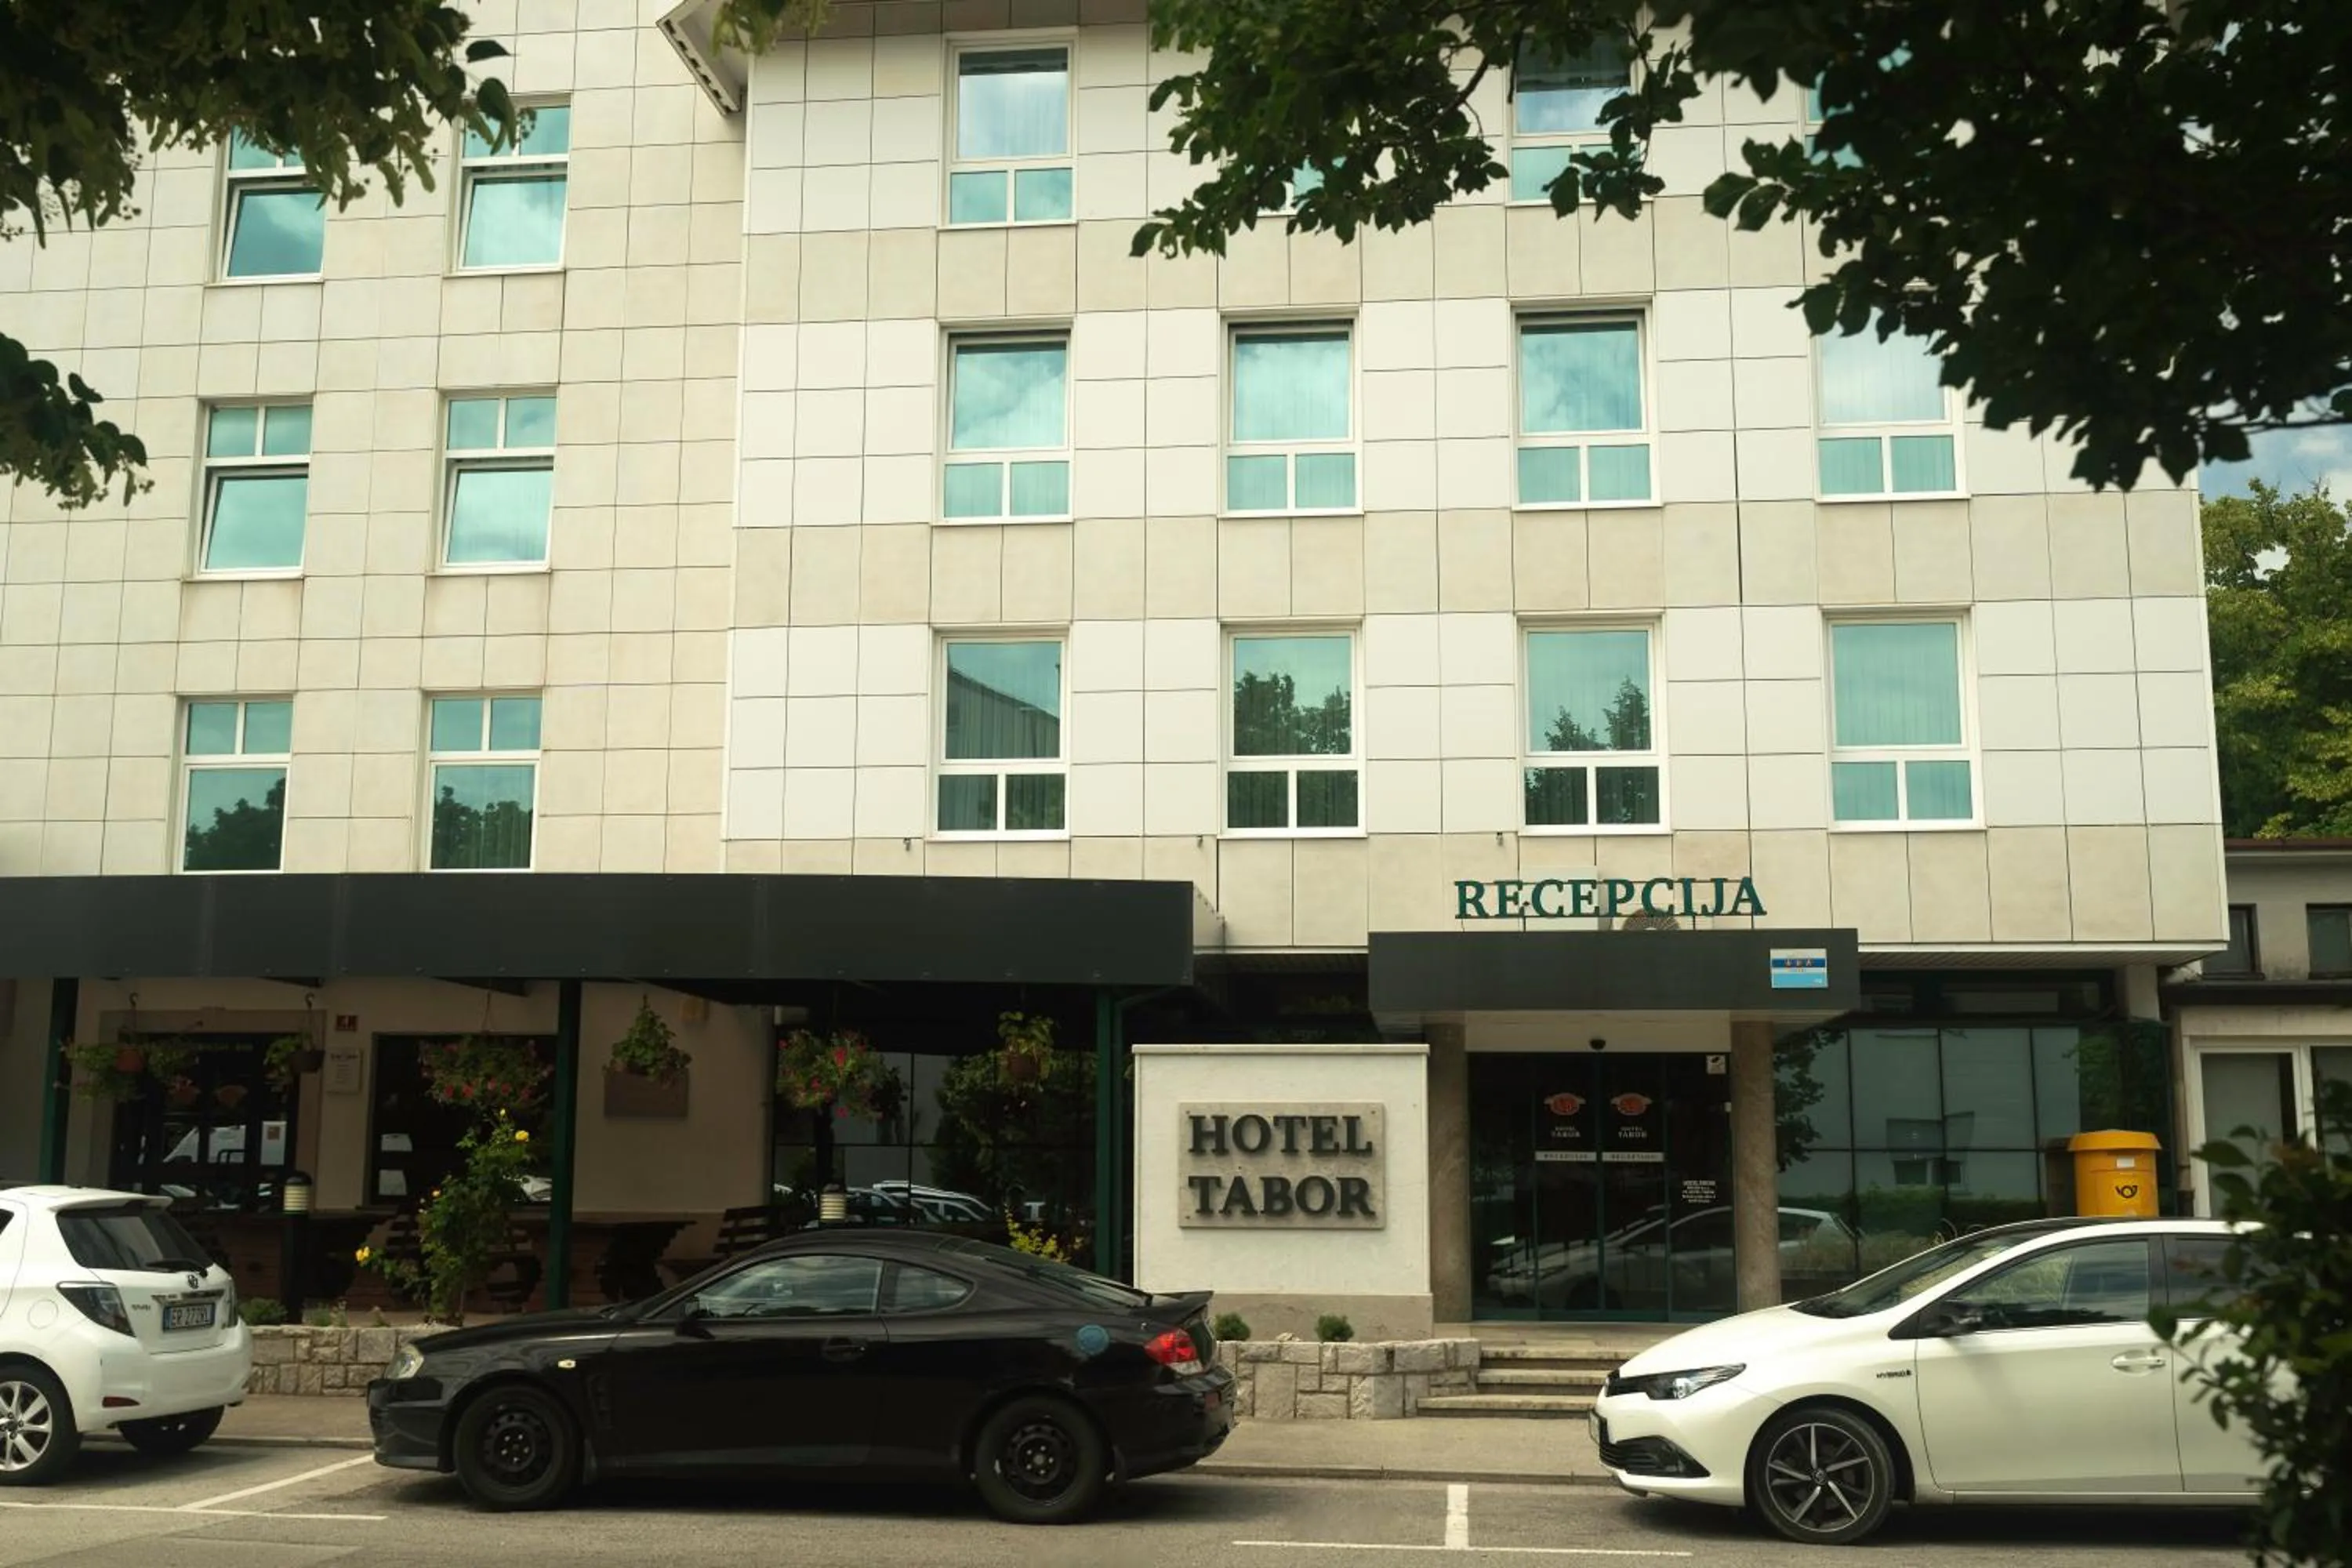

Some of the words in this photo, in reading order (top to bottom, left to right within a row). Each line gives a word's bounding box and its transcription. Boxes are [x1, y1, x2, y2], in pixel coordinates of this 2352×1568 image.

[1454, 877, 1767, 919] RECEPCIJA
[1188, 1114, 1373, 1156] HOTEL
[1188, 1175, 1375, 1218] TABOR
